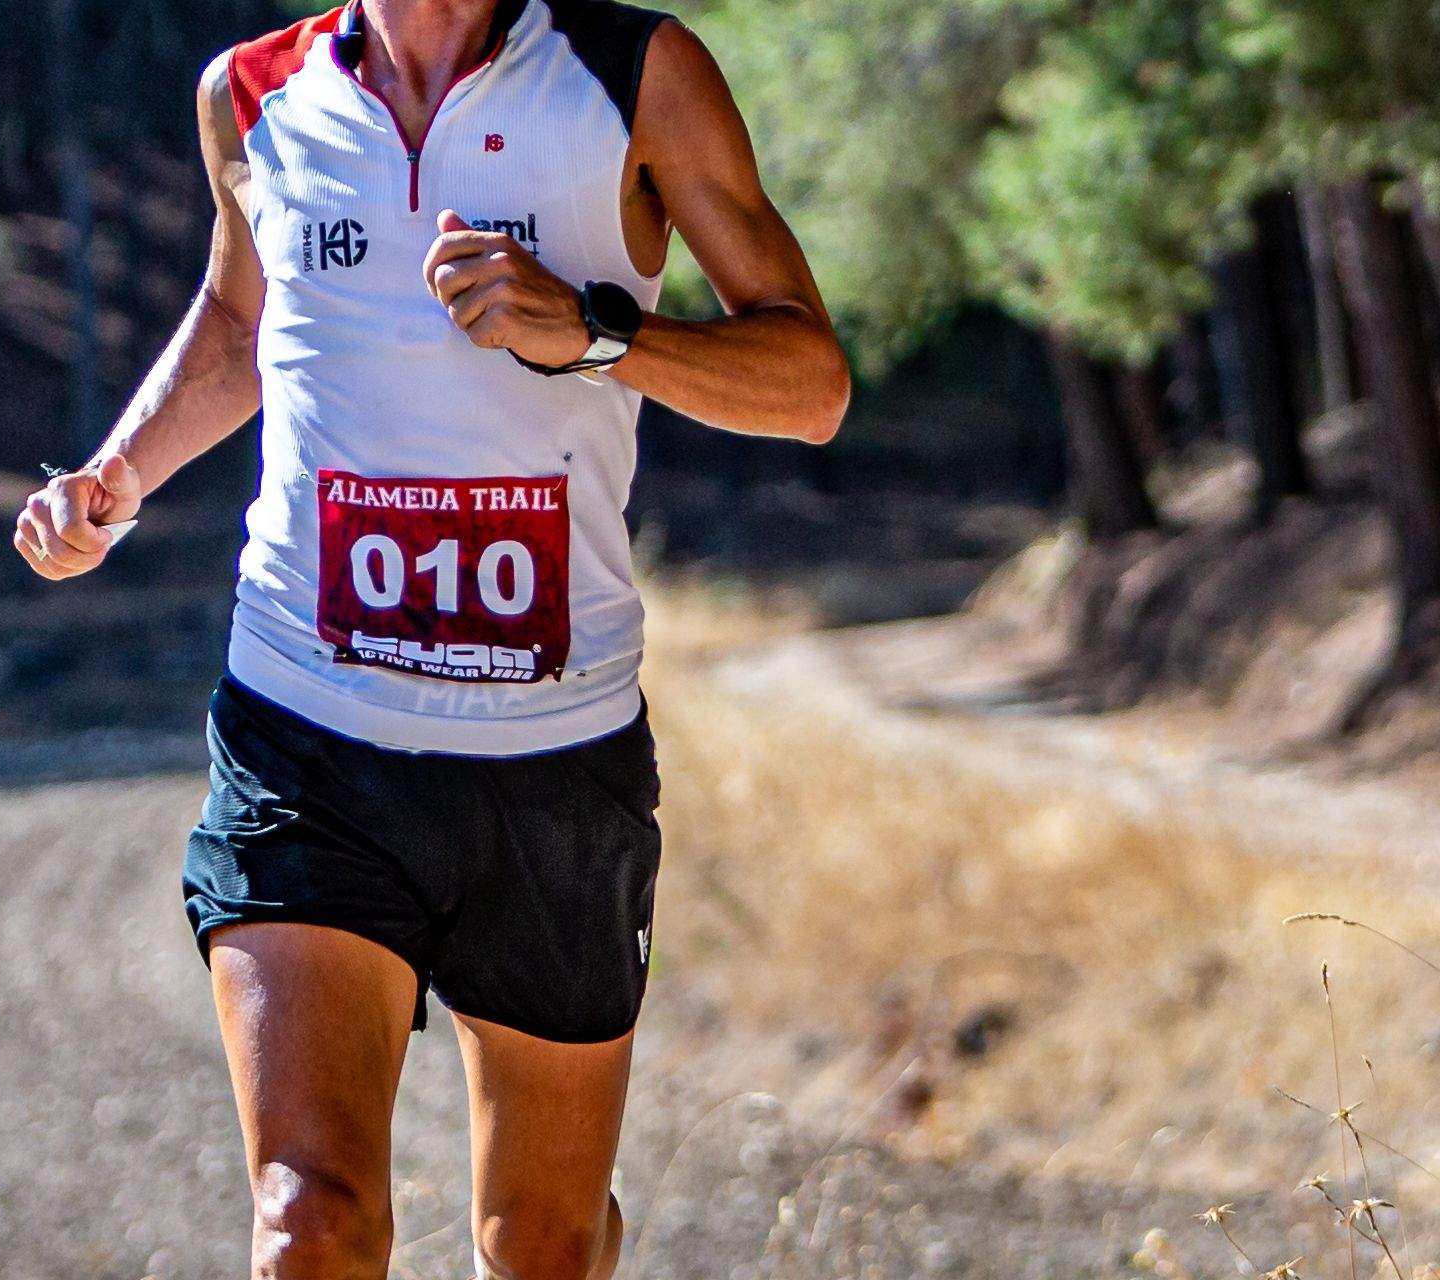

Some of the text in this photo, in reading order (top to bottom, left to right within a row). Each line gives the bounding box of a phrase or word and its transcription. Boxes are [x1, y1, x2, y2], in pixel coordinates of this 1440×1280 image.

[327, 478, 558, 511] ALAMEDA TRAIL
[350, 534, 534, 615] 010
[421, 661, 479, 678] WEAR
